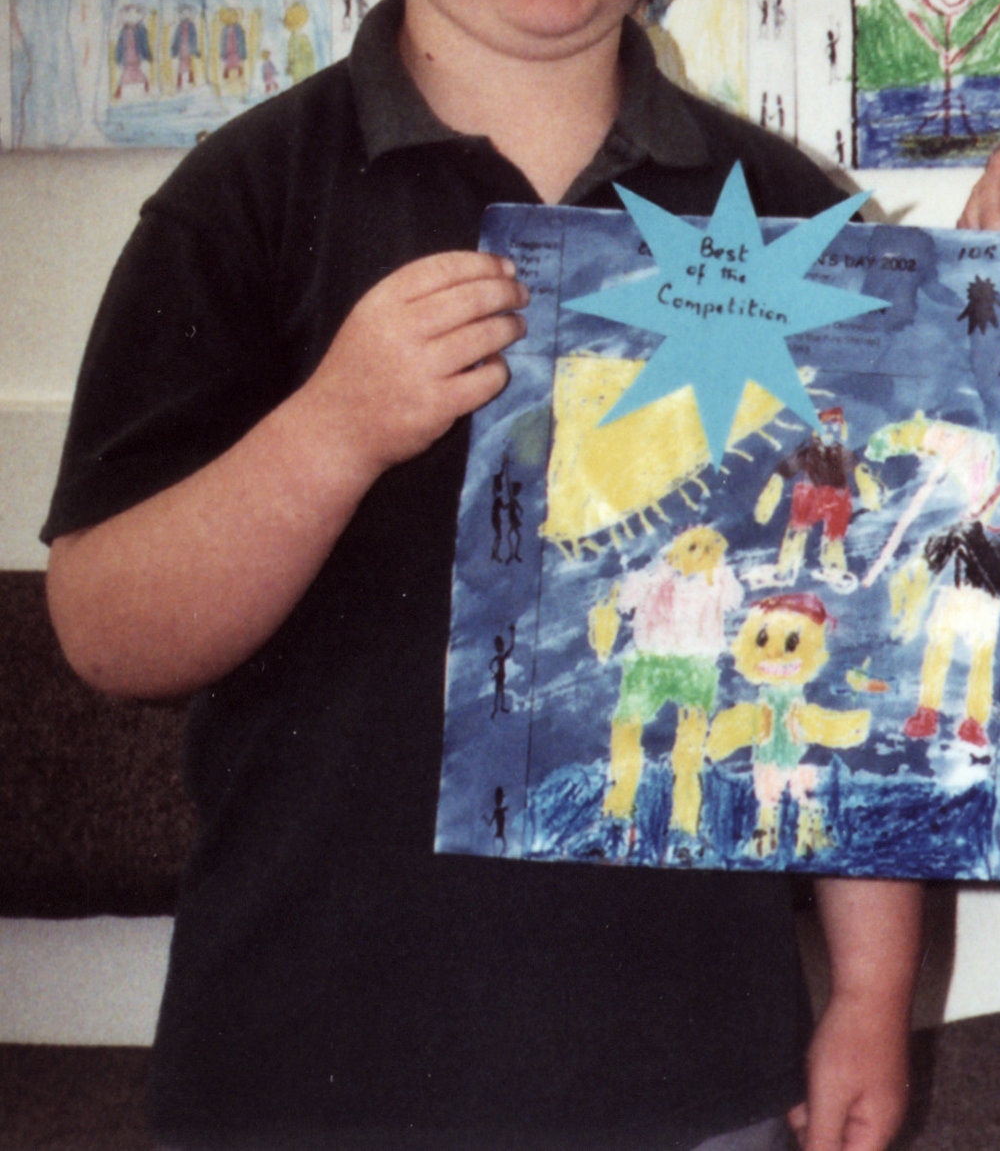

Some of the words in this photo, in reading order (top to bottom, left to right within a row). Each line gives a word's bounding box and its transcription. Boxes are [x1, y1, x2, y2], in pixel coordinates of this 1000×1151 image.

[699, 235, 749, 263] Best
[685, 263, 706, 285] of
[720, 266, 747, 284] the
[844, 254, 876, 269] DAY
[879, 256, 917, 272] 2002
[657, 282, 789, 323] Competition
